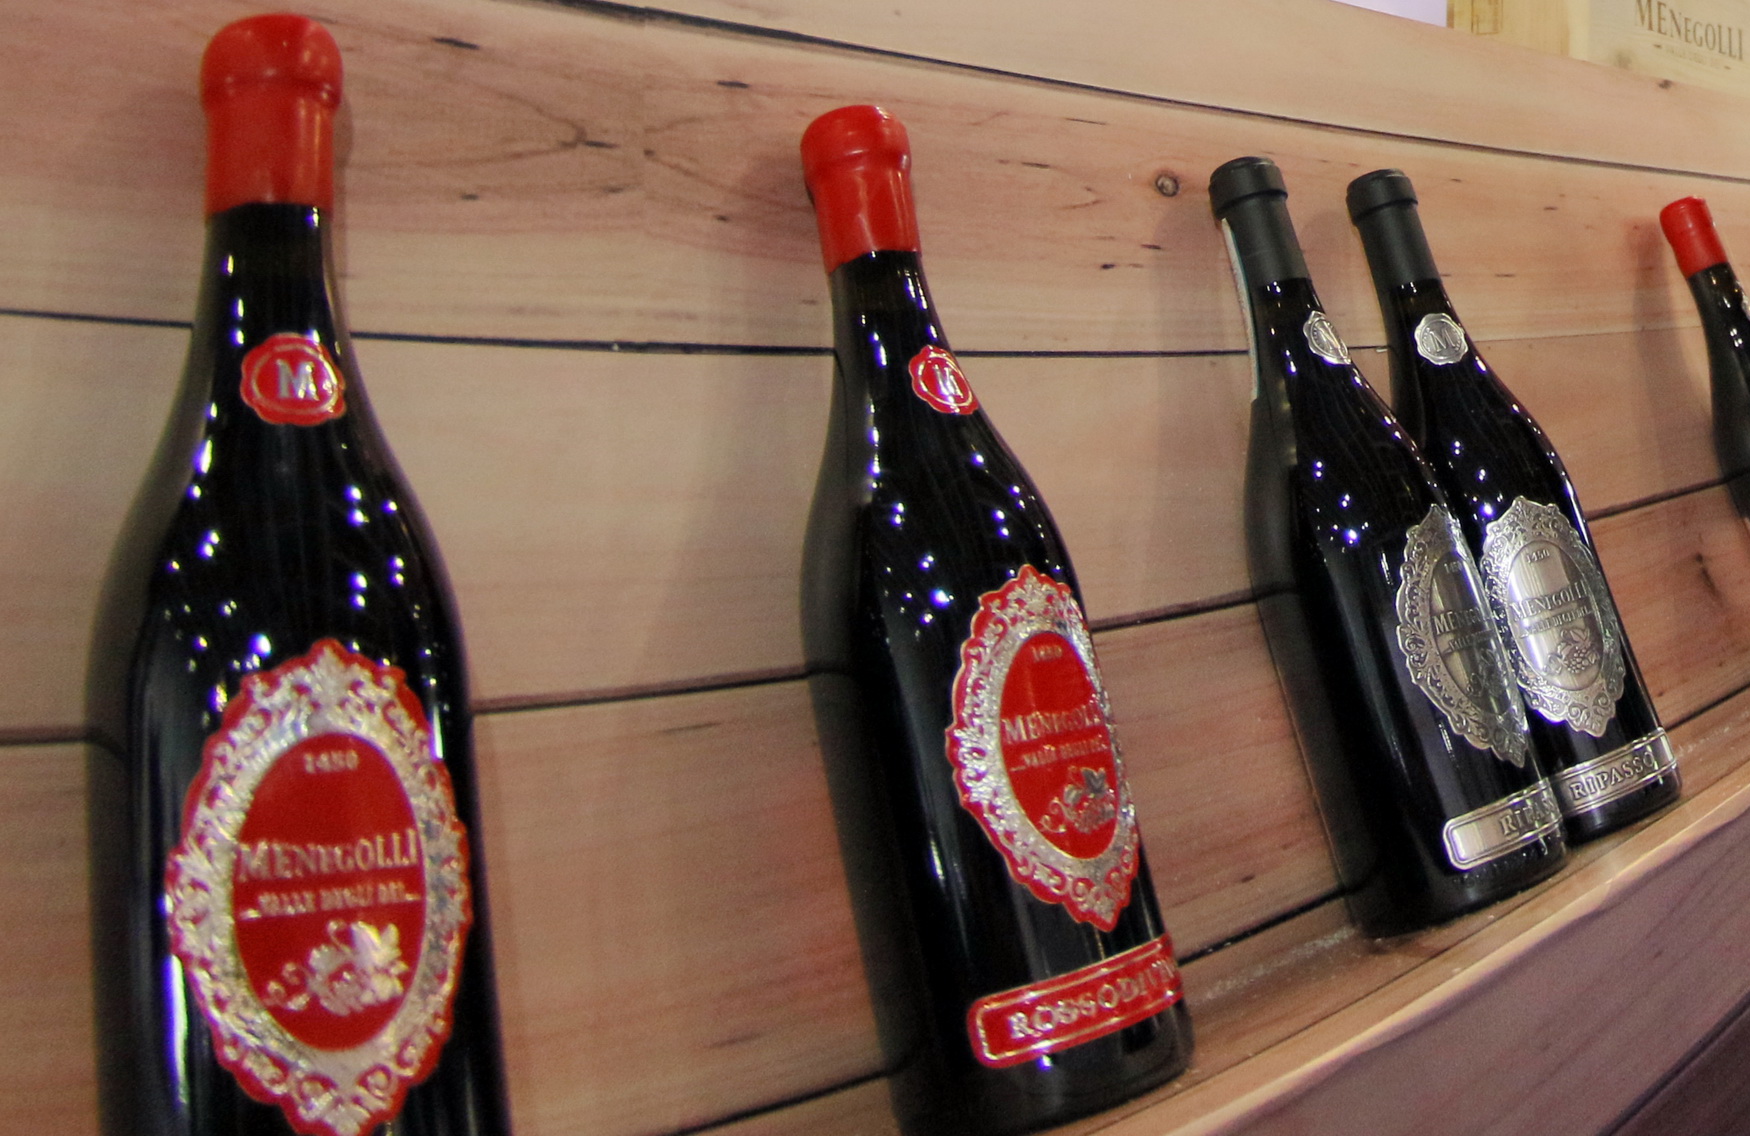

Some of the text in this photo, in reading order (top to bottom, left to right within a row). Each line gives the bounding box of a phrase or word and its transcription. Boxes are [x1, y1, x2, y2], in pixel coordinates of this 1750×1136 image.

[276, 358, 320, 401] M
[1526, 548, 1550, 564] 1450
[1509, 578, 1588, 622] MENEGOLLI
[1570, 749, 1656, 801] RIPASSO
[236, 828, 418, 882] MENEGOLLI
